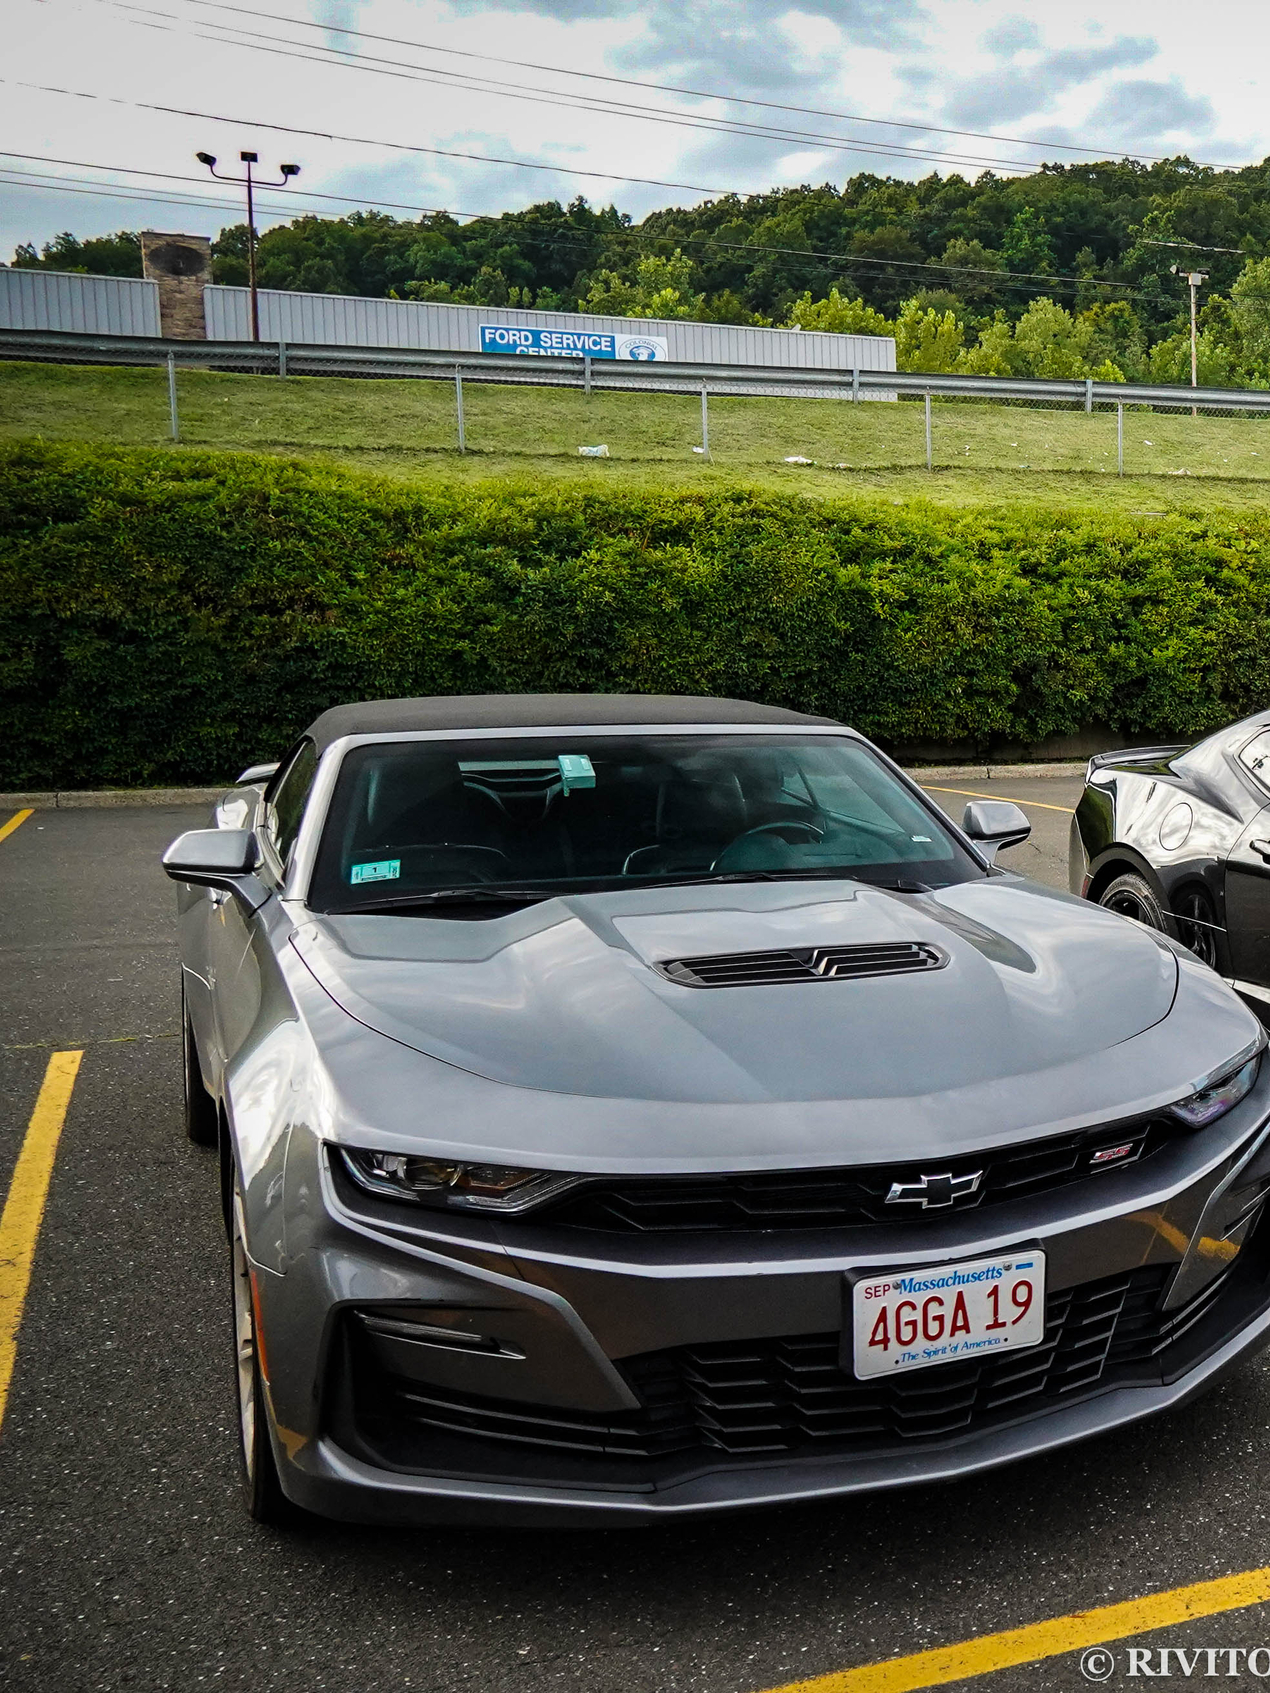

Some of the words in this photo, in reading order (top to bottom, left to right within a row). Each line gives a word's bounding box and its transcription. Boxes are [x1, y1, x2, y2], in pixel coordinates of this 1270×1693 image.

[484, 329, 533, 345] FORD
[540, 332, 612, 351] SERVICE
[864, 1283, 891, 1300] SEP
[899, 1265, 1003, 1295] Massachusetts
[868, 1290, 971, 1351] 4GGA
[985, 1279, 1033, 1331] 19
[900, 1352, 919, 1363] The
[922, 1346, 947, 1359] Spirit
[950, 1344, 959, 1355] of
[961, 1338, 1001, 1351] America
